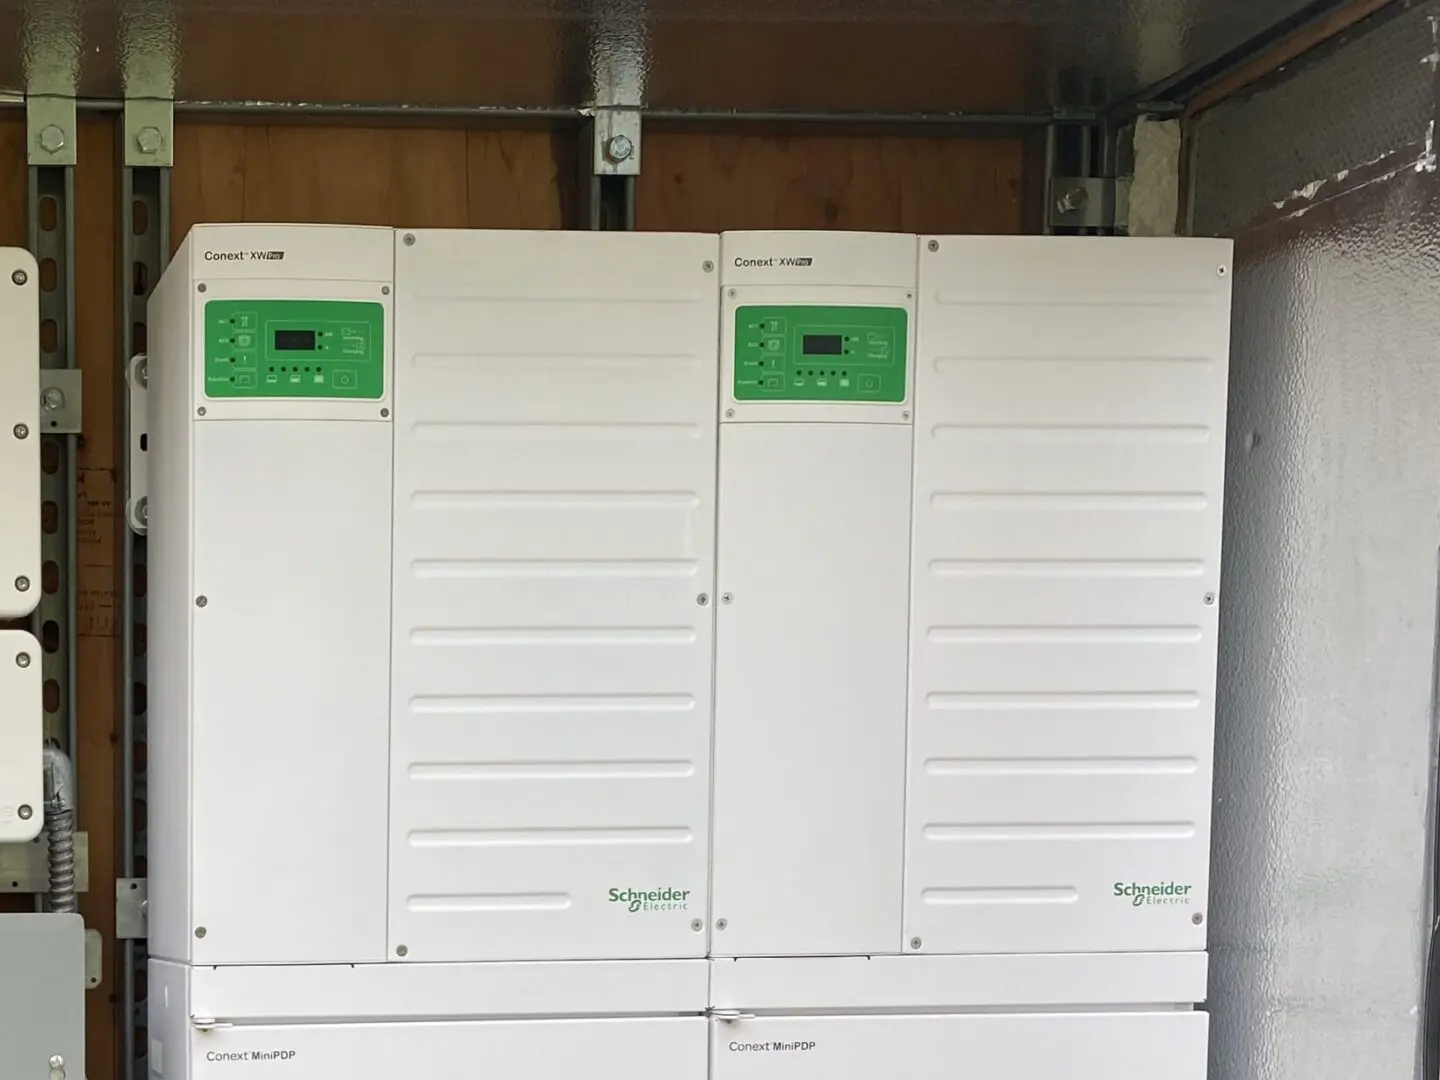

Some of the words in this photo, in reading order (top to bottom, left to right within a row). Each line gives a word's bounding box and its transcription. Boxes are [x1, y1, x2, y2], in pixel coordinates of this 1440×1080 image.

[204, 251, 244, 260] Conext
[734, 258, 773, 266] Conext
[1114, 882, 1192, 896] Schneider
[609, 887, 690, 902] Schneider
[1146, 896, 1189, 904] Electric
[644, 902, 688, 910] Electric
[729, 1042, 770, 1052] Conext
[773, 1042, 816, 1050] MiniPDP
[206, 1051, 248, 1061] Conext
[252, 1051, 296, 1060] MiniPDP
